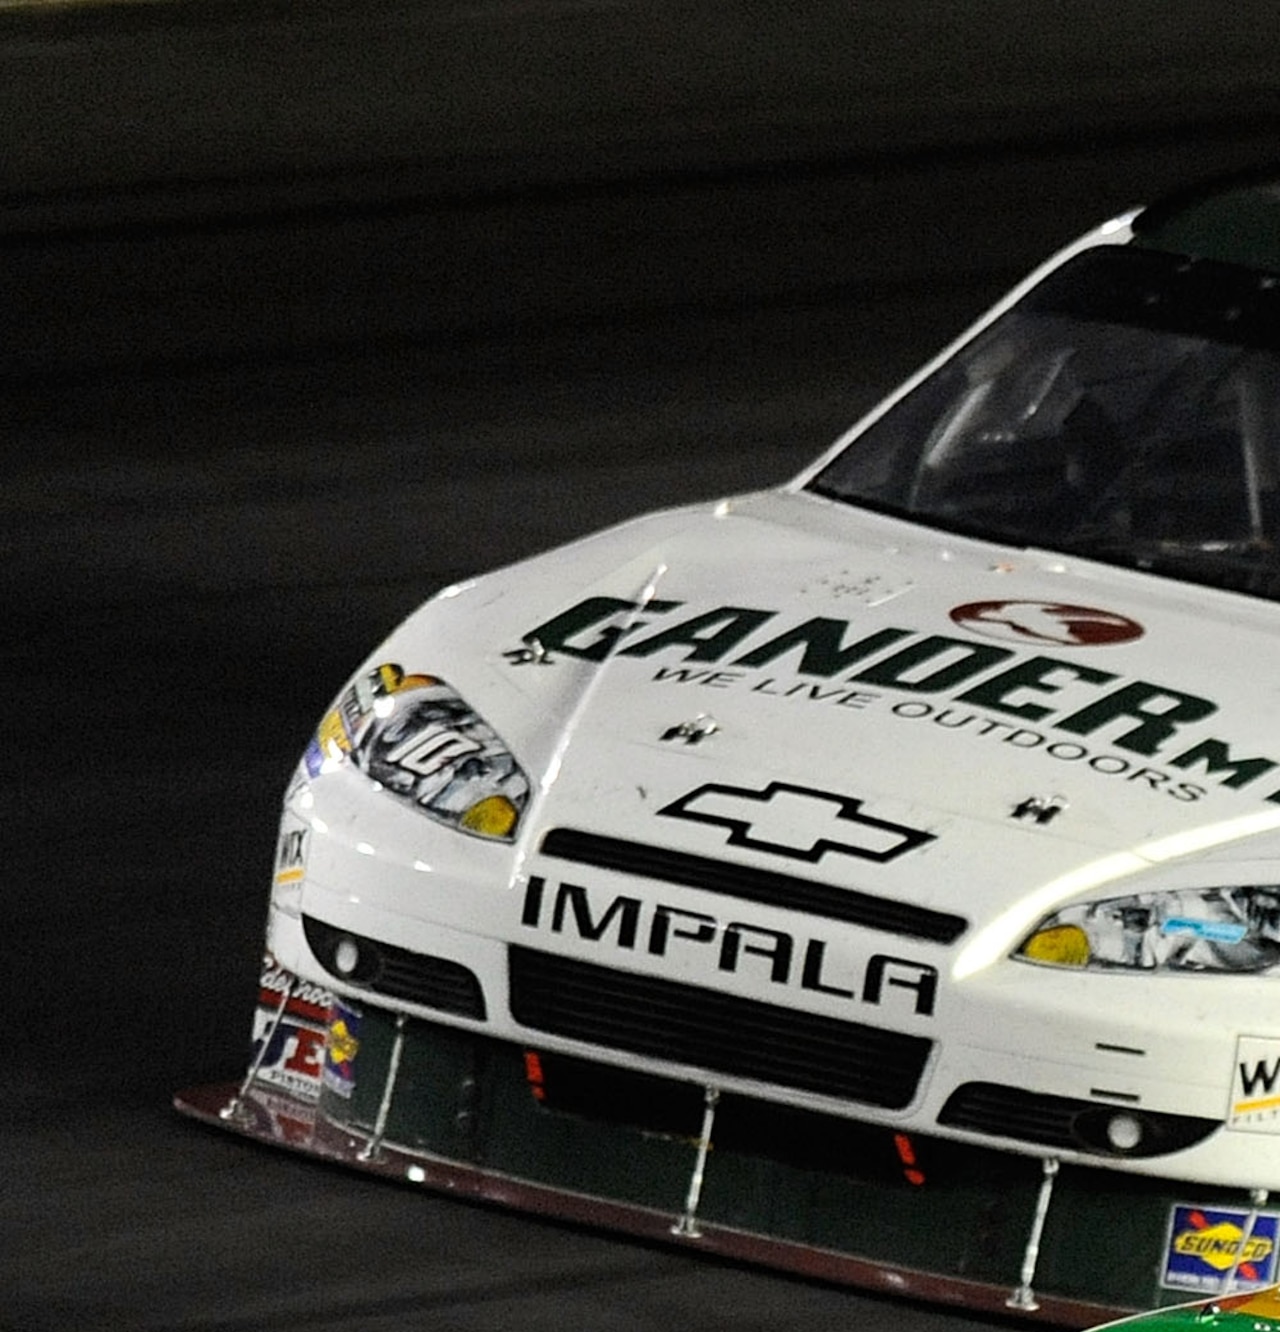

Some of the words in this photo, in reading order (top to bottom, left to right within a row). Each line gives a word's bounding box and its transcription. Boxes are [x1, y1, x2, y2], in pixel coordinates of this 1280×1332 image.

[522, 596, 1218, 757] GANDER
[651, 667, 736, 690] WE
[751, 679, 881, 711] LIVE
[891, 701, 1207, 803] OUTDOORS
[386, 722, 484, 777] 10
[519, 874, 940, 1017] IMPALA
[1180, 1233, 1272, 1259] SUNOCO
